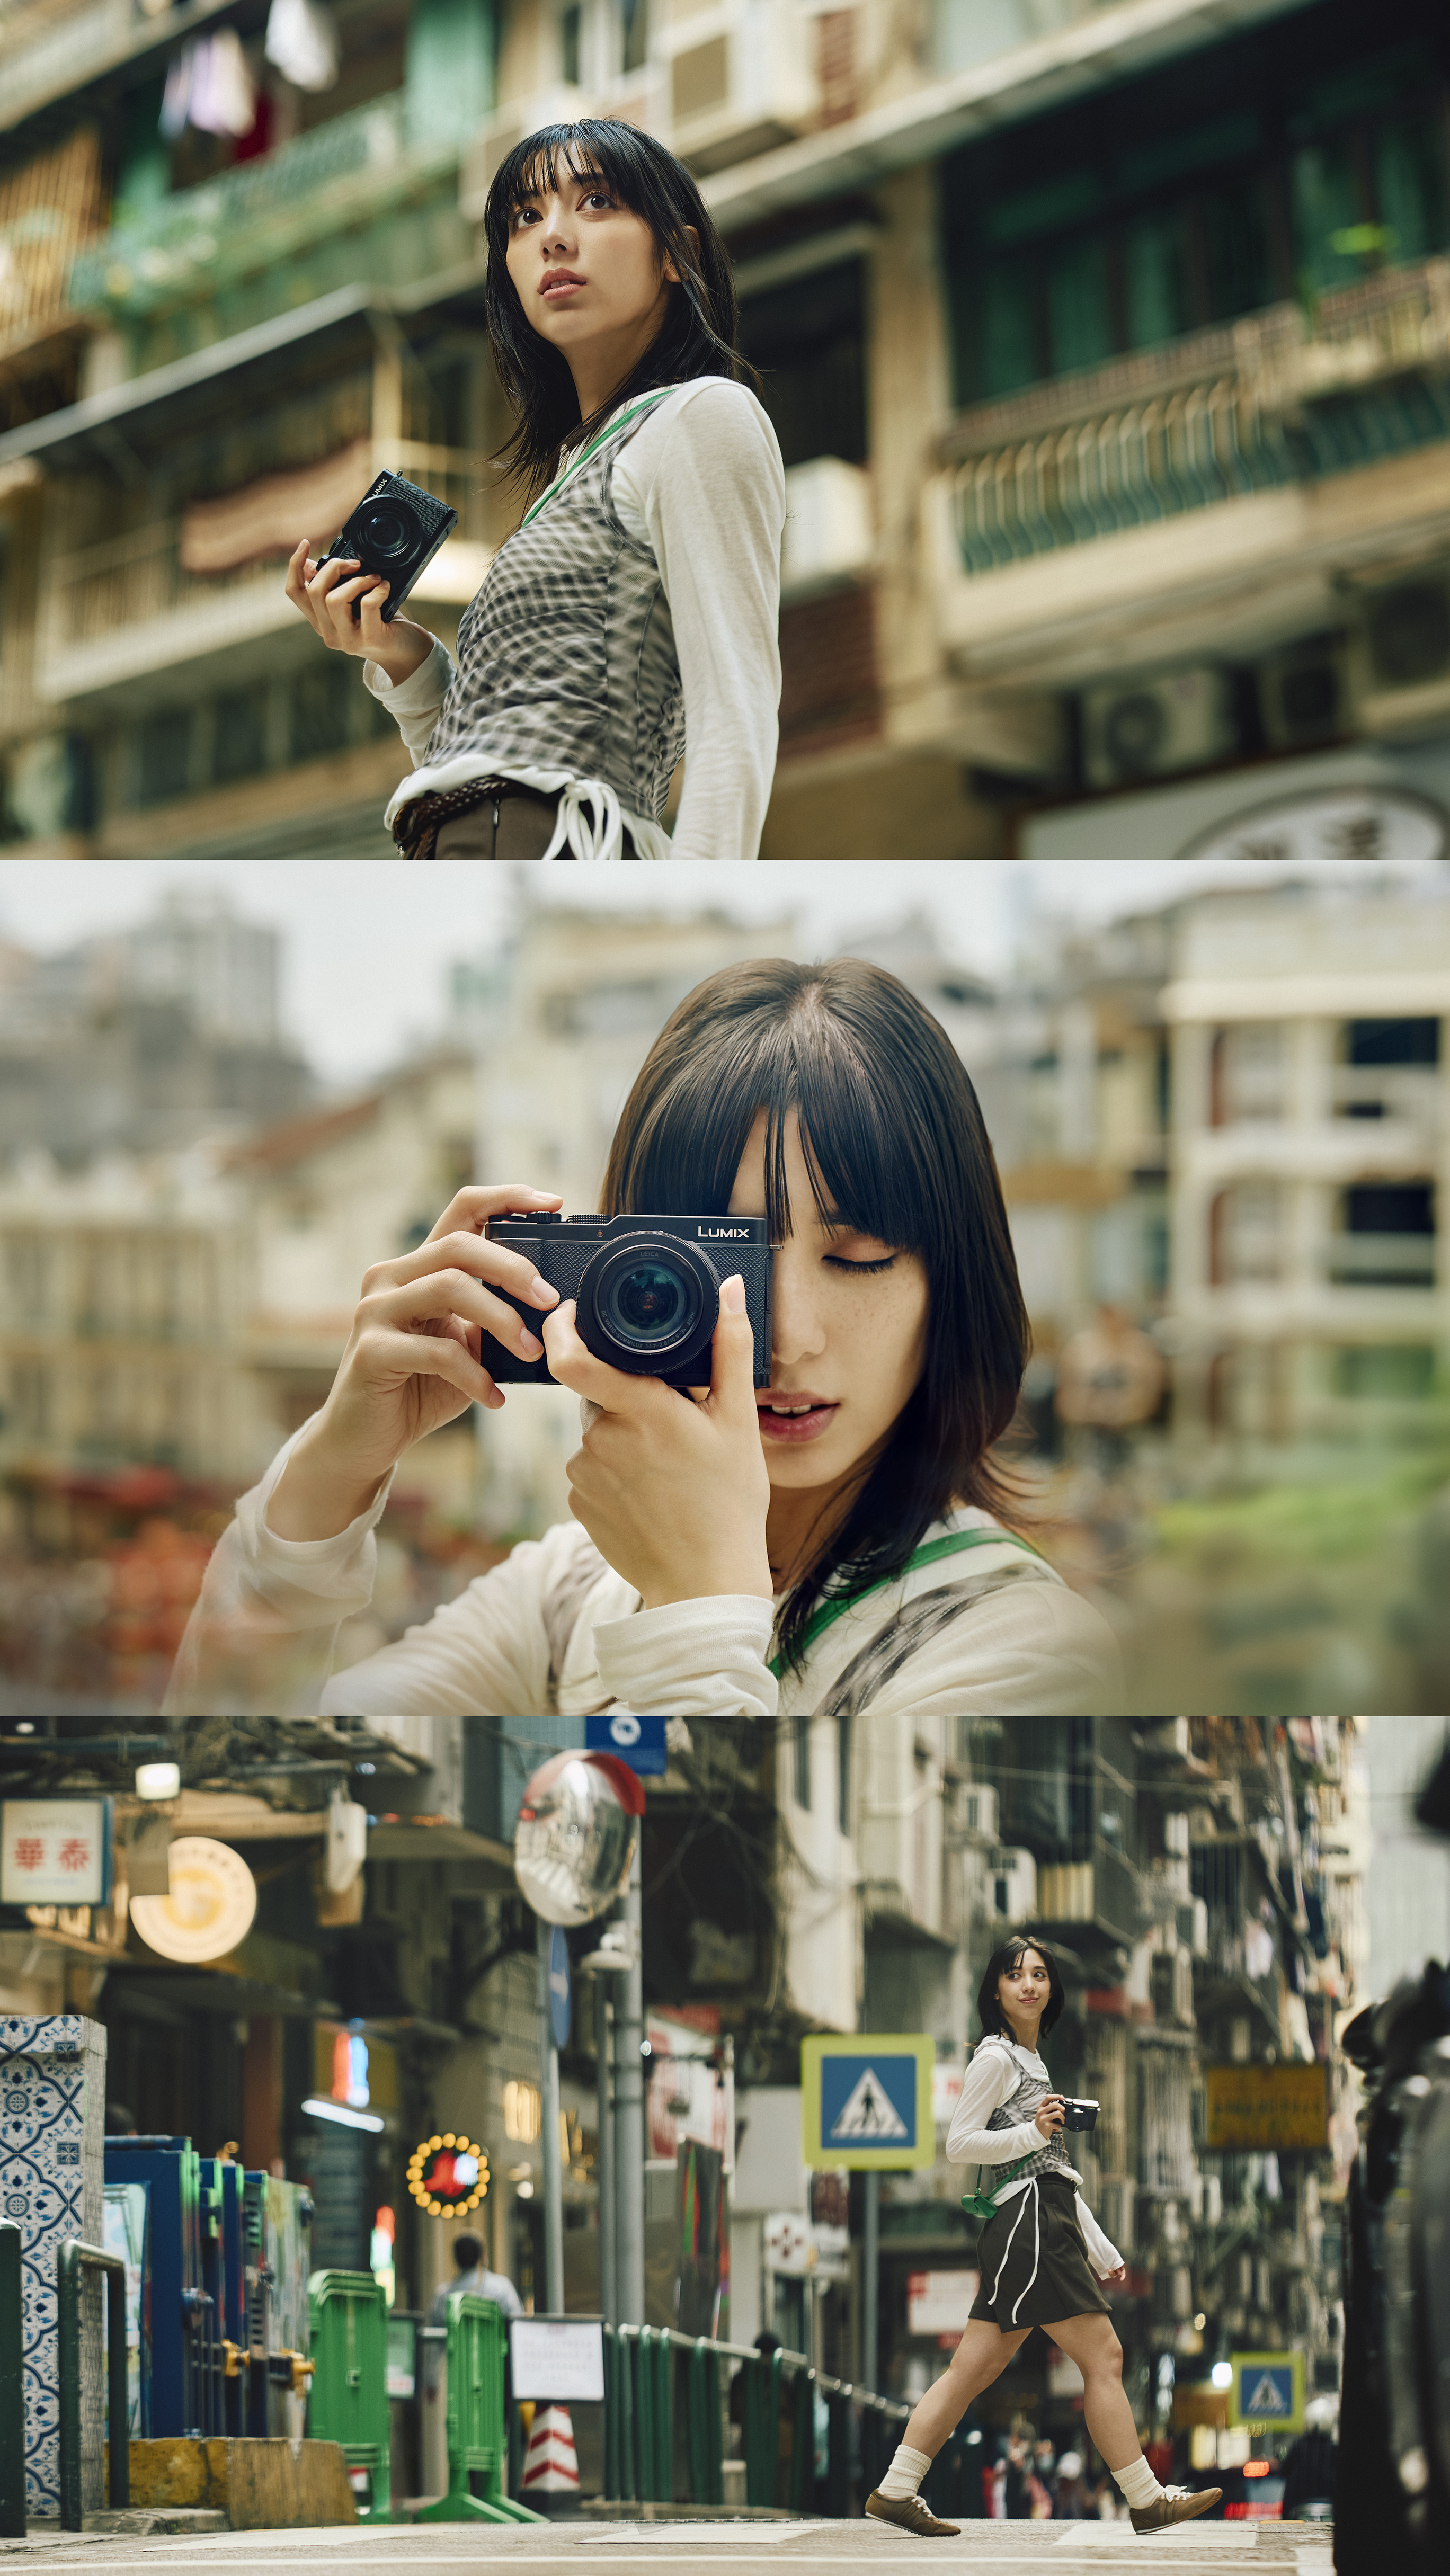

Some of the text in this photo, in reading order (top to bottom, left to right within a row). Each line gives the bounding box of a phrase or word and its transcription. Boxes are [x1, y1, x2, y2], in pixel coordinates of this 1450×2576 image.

[372, 478, 388, 497] UMIX
[698, 1226, 750, 1238] LUMIX
[687, 1312, 696, 1325] ASPH
